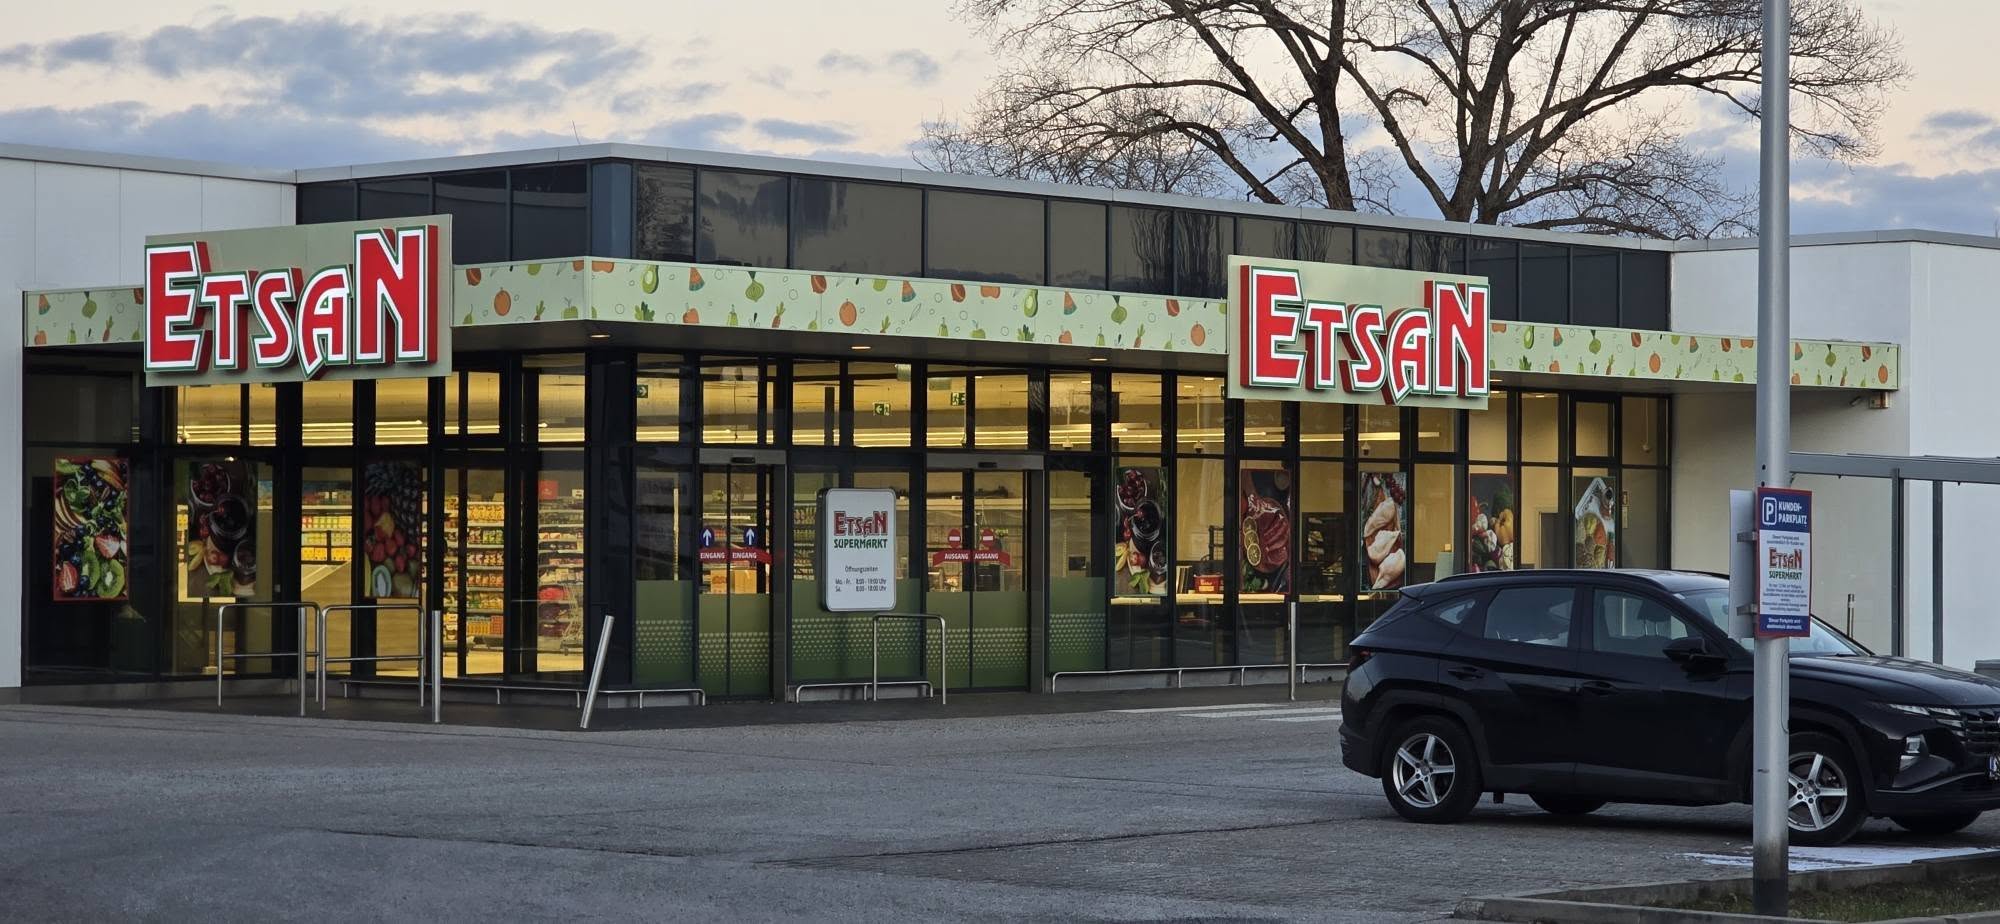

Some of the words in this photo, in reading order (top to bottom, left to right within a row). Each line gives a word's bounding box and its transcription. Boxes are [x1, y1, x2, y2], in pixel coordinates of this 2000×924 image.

[144, 223, 438, 380] ETSAN
[1240, 265, 1491, 404] ETSAN
[1766, 502, 1774, 521] P
[1778, 501, 1802, 512] KUNDEN-
[834, 510, 888, 537] ETSAN
[1778, 513, 1807, 525] PARKPLATZ
[834, 539, 888, 549] SUPERMARKT
[944, 552, 969, 560] AUSGANG
[974, 552, 999, 560] AUSGANG
[1769, 547, 1802, 571] ETSAN
[1769, 570, 1802, 581] SUPERMARKT
